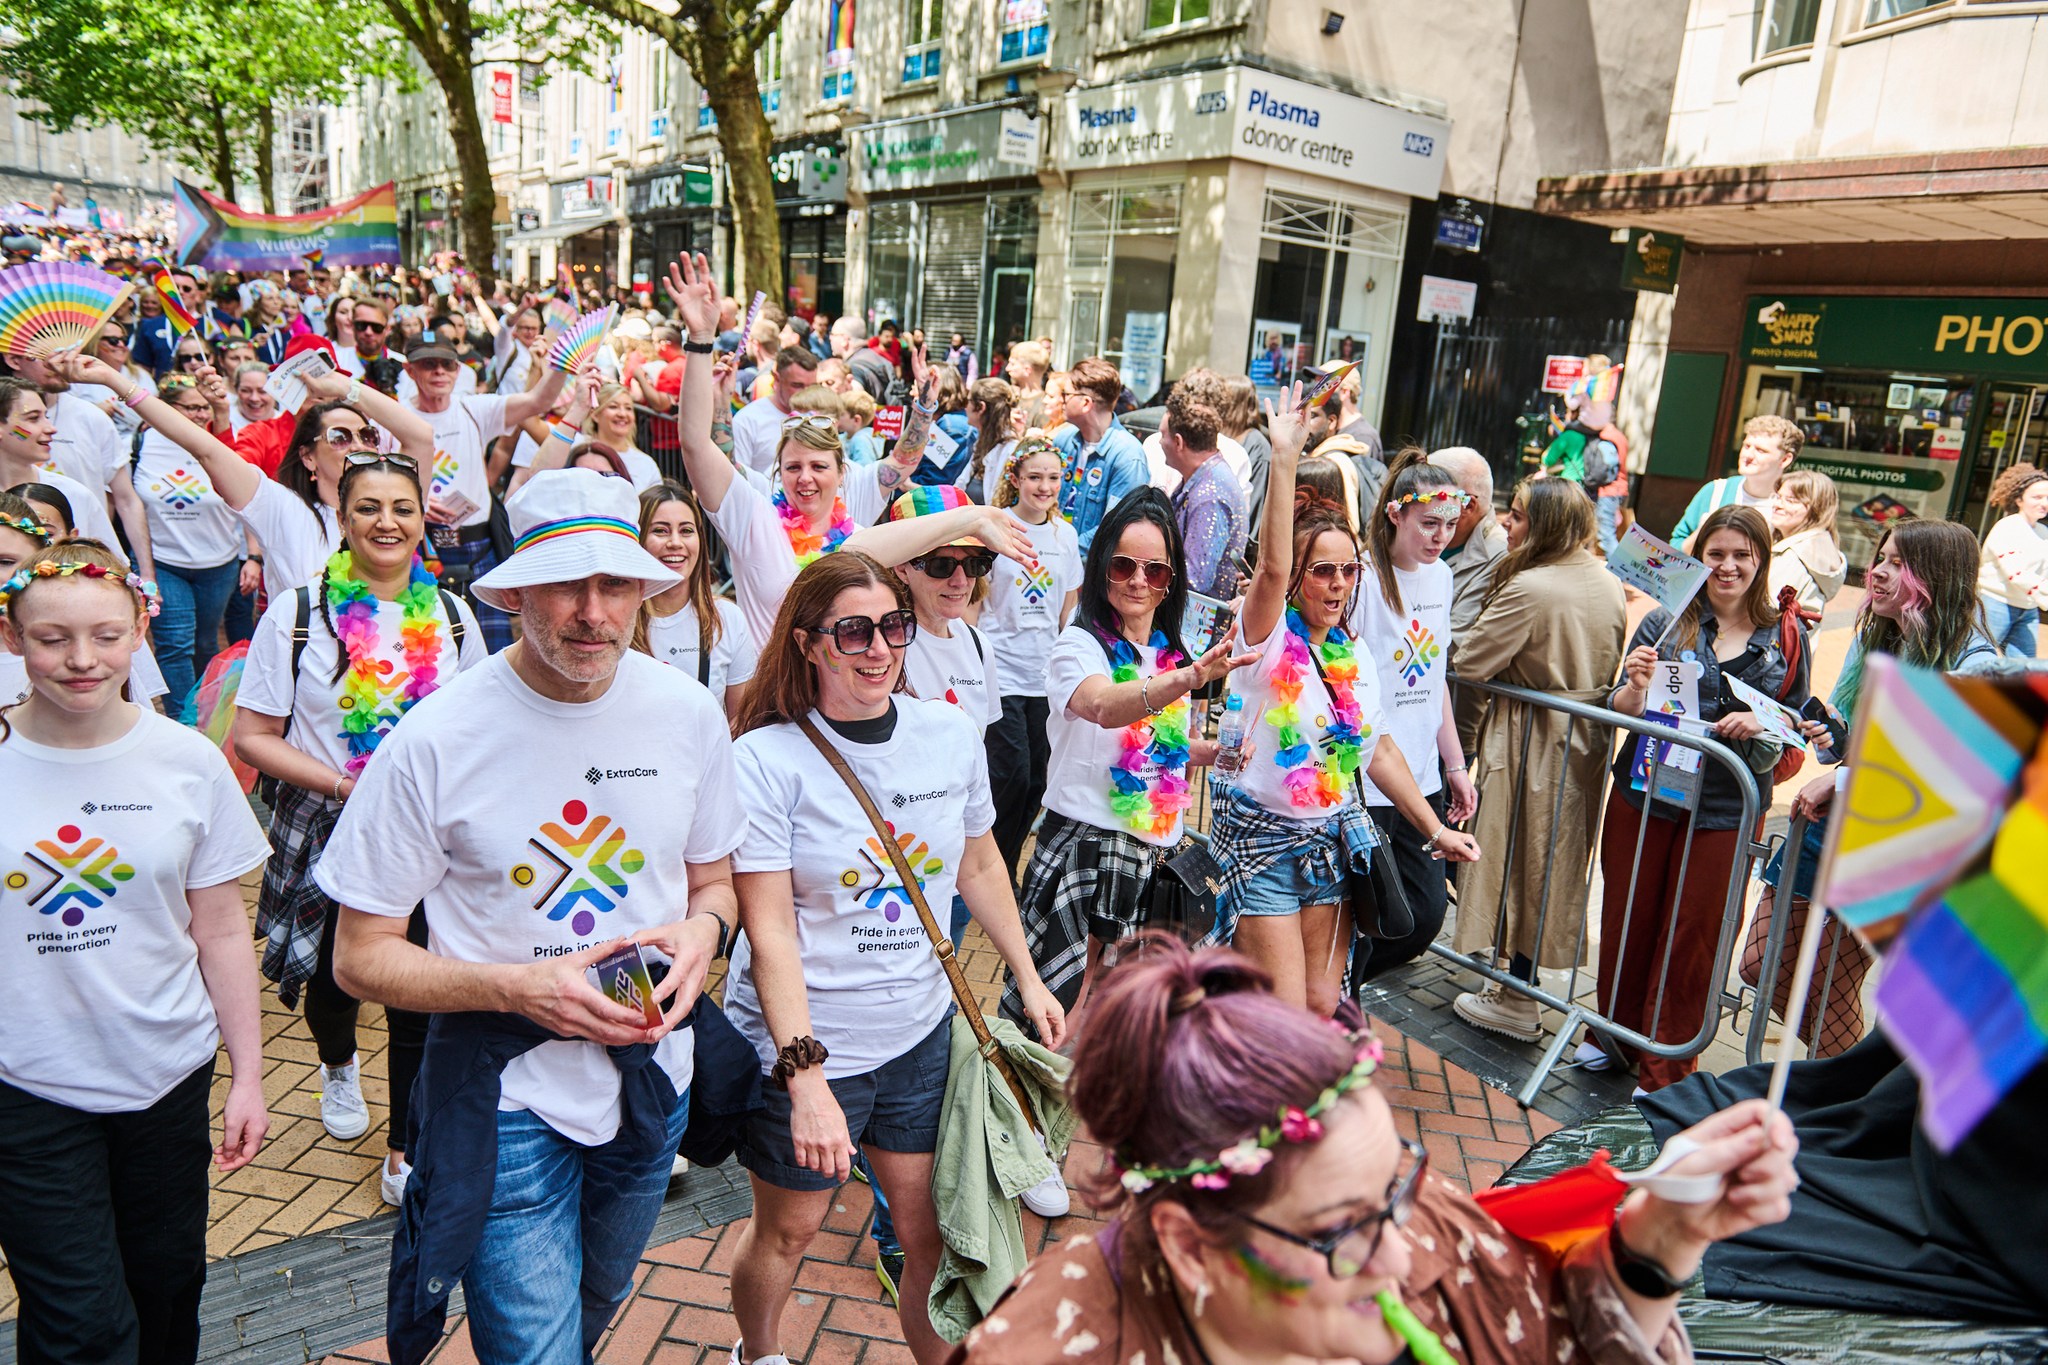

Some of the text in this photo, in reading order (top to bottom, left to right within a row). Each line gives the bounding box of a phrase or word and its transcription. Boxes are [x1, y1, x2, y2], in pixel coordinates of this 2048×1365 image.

[1199, 92, 1227, 114] NHS
[1247, 89, 1321, 128] Plasma
[1079, 105, 1136, 128] Plasma
[1078, 131, 1174, 157] donor centre
[1243, 121, 1354, 167] donor centre
[1403, 132, 1434, 157] NHS
[649, 174, 683, 208] KFC
[1765, 311, 1820, 332] SNAPPY
[1770, 329, 1815, 346] SNAPS
[1934, 314, 2048, 357] PHO
[1816, 463, 1858, 479] DIGITAL
[1860, 469, 1907, 484] PHOTOS
[606, 767, 658, 779] ExtraCare
[909, 789, 948, 803] ExtraCar
[101, 803, 153, 812] ExtraCare
[27, 924, 118, 942] Pride in every
[851, 924, 926, 938] Pride in every
[37, 937, 111, 955] generation
[533, 943, 573, 958] Pride
[857, 939, 920, 953] generation
